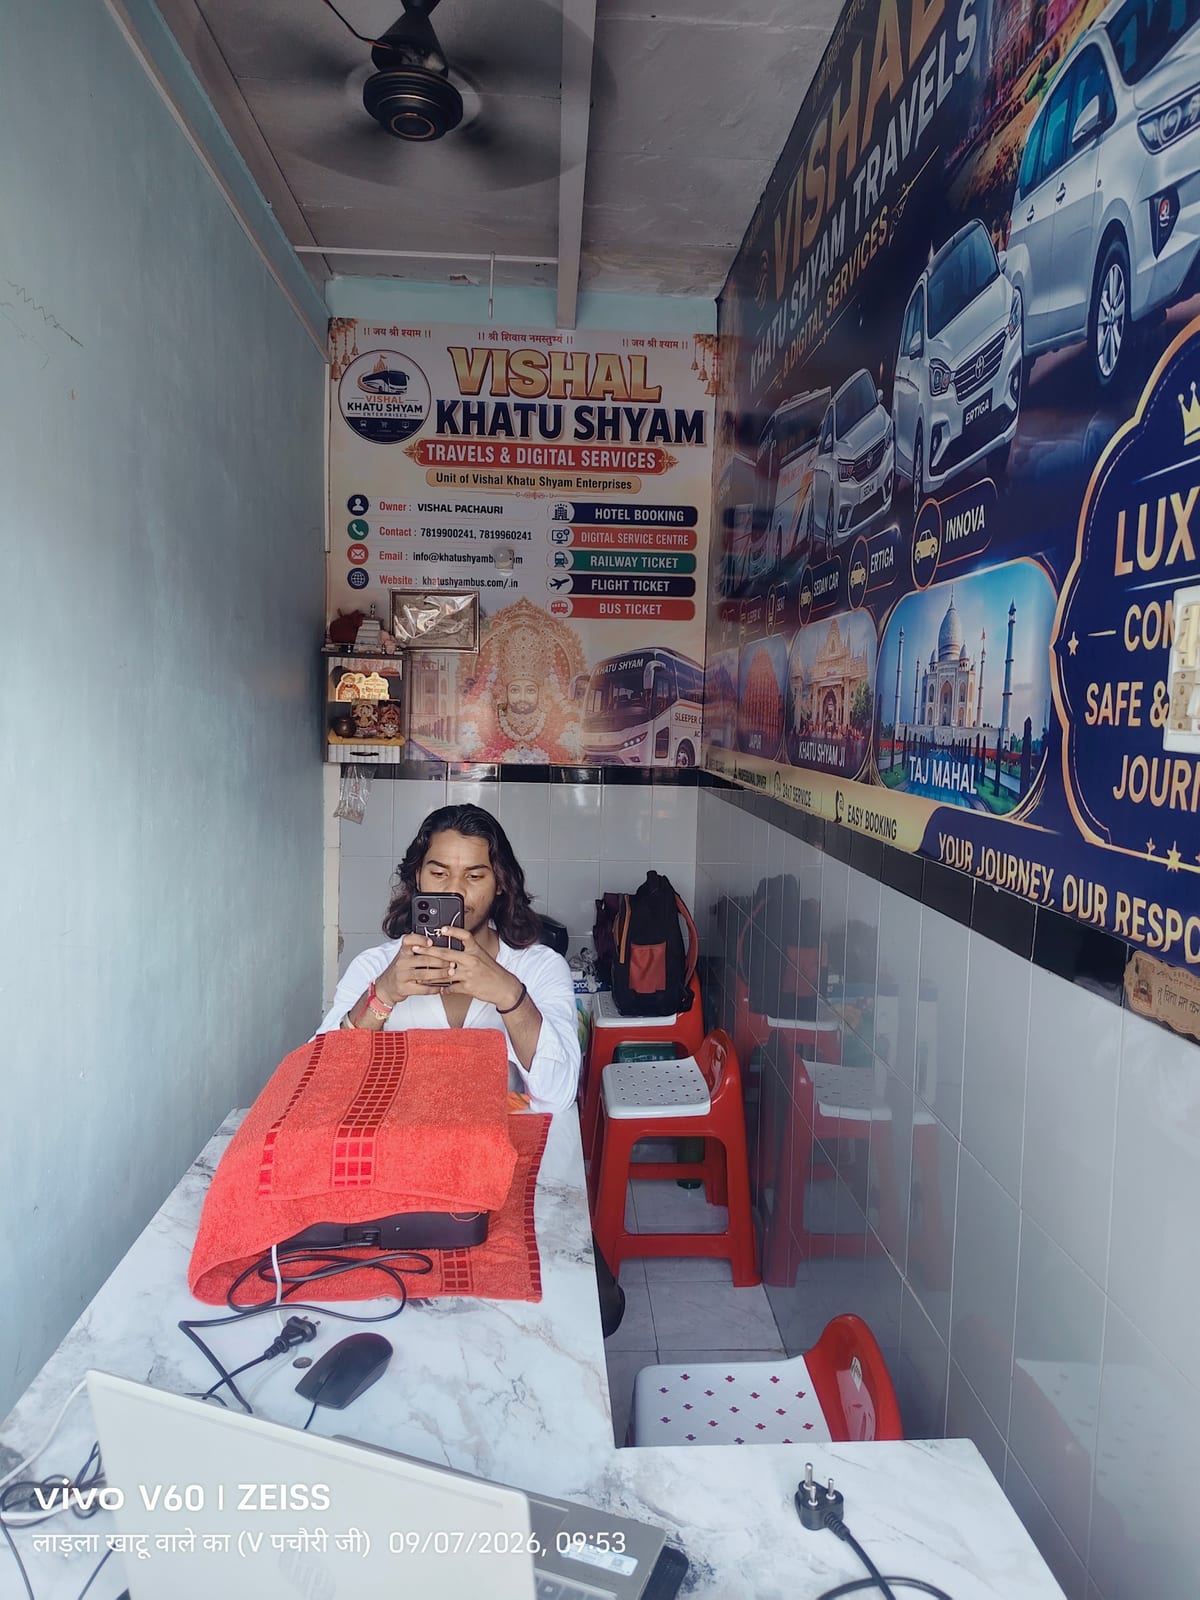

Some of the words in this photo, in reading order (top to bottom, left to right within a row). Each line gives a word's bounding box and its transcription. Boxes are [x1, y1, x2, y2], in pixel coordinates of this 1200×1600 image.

[750, 298, 788, 393] KHATU
[790, 198, 847, 330] SHYAM
[853, 0, 977, 235] TRAVELS
[790, 301, 824, 364] DIGITAL
[826, 205, 888, 319] SERVICES
[373, 328, 387, 337] जय
[388, 327, 399, 337] श्री
[401, 329, 421, 338] श्याम
[501, 330, 526, 343] शिवाय
[631, 338, 645, 348] जय
[658, 339, 679, 349] श्याम
[447, 346, 661, 403] VISHAL
[347, 402, 383, 411] KHATU
[386, 403, 422, 413] SHYAM
[365, 395, 404, 403] VISHAL
[965, 399, 989, 425] ERTIGA
[435, 400, 563, 440] KHATU
[573, 405, 704, 444] SHYAM
[426, 444, 494, 464] TRAVELS
[500, 449, 511, 464] &
[516, 448, 575, 467] DIGITAL
[581, 451, 656, 469] SERVICES
[436, 473, 457, 484] Unit
[459, 473, 469, 484] of
[472, 474, 503, 485] Vishal
[507, 475, 535, 487] Khatu
[539, 476, 573, 489] Shyam
[576, 478, 632, 491] Enterprises
[417, 503, 452, 513] VISHAL
[455, 504, 503, 514] PACHAURI
[595, 508, 630, 521] HOTEL
[634, 510, 684, 522] BOOKING
[945, 504, 985, 543] INNOVA
[420, 527, 477, 539] 7819900241,
[479, 529, 532, 541] 7819960241
[581, 532, 615, 544] DIGITAL
[618, 532, 653, 544] SERVICE
[656, 534, 689, 546] CENTRE
[590, 555, 638, 568] RAILWAY
[641, 556, 679, 568] TICKET
[870, 545, 894, 574] ERTIGA
[422, 576, 518, 589] khatushyambus.com/.in
[591, 578, 630, 592] FLIGHT
[632, 580, 670, 592] TICKET
[813, 575, 829, 597] SEDAN
[829, 571, 840, 590] CAR
[599, 602, 622, 614] BUS
[625, 604, 662, 615] TICKET
[618, 658, 644, 670] SHYAM
[1084, 681, 1143, 727] SAFE
[1150, 680, 1170, 728] &
[674, 712, 698, 723] SLEEPER
[798, 741, 816, 761] KHATU
[817, 743, 838, 767] SHYAM
[838, 747, 846, 768] JI
[909, 756, 929, 785] TAJ
[932, 759, 977, 795] MAHAL
[792, 785, 812, 807] SERVICE
[847, 804, 863, 828] EASY
[864, 810, 897, 841] BOOKING
[938, 832, 973, 872] YOUR
[976, 845, 1055, 907] JOURNEY,
[1062, 874, 1107, 928] OUR
